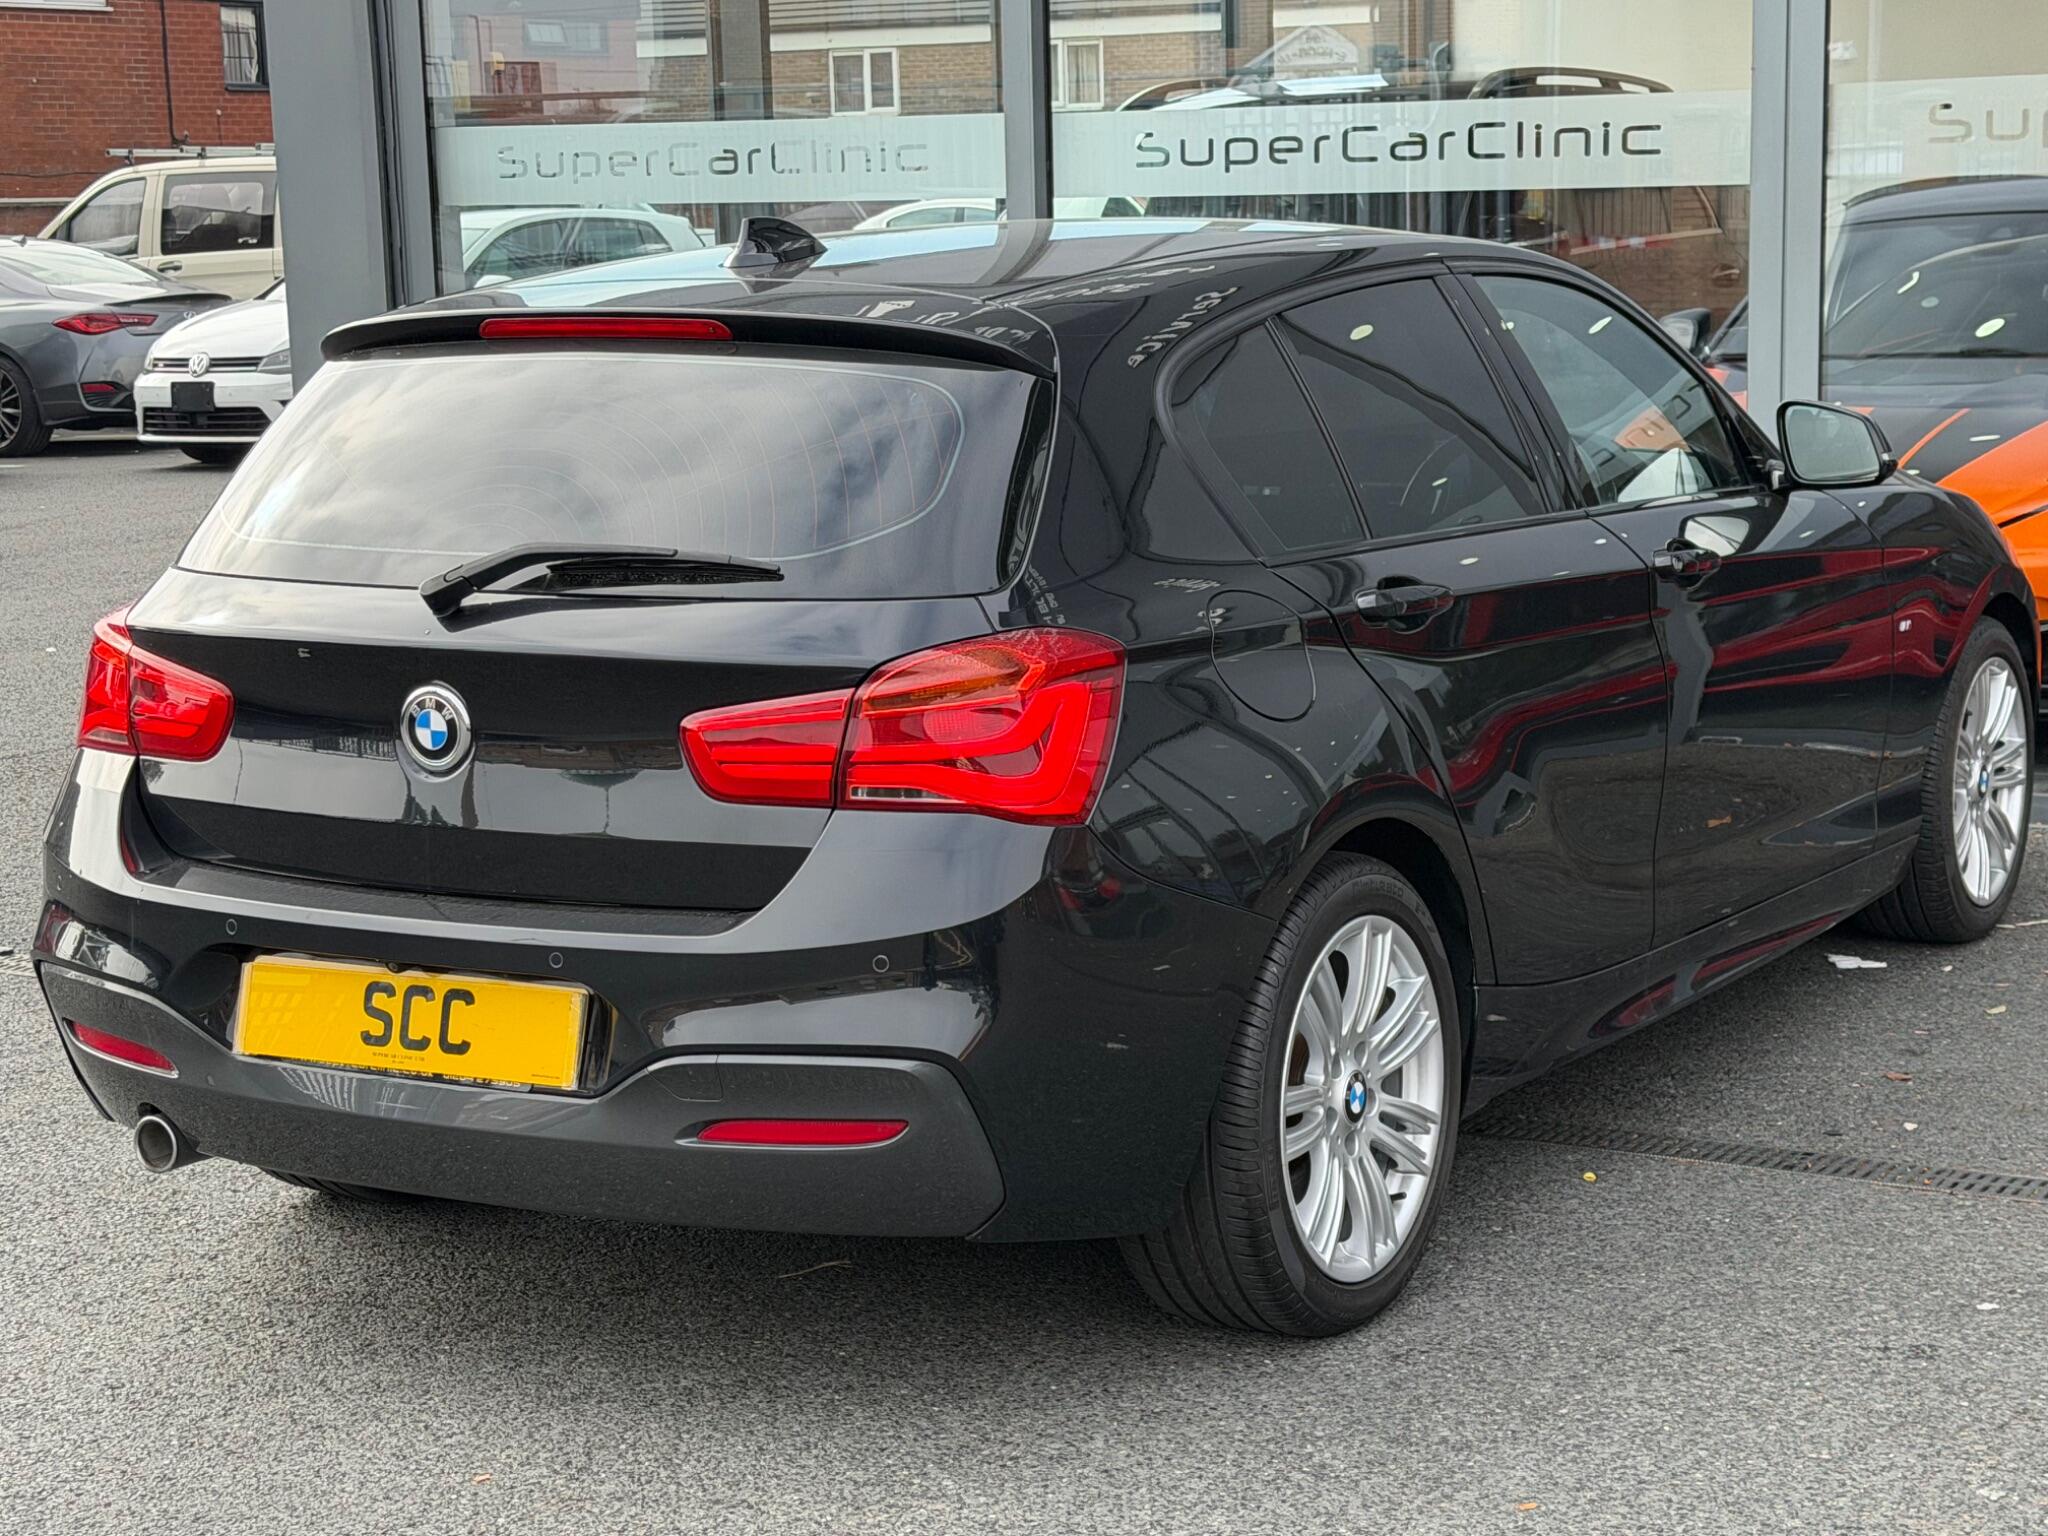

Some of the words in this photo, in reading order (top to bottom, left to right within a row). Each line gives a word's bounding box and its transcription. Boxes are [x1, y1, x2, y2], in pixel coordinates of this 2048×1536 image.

[497, 139, 929, 185] SuperCarClinic
[1135, 120, 1663, 173] SuperCarClinic
[410, 697, 454, 721] BMW
[360, 980, 476, 1056] SCC
